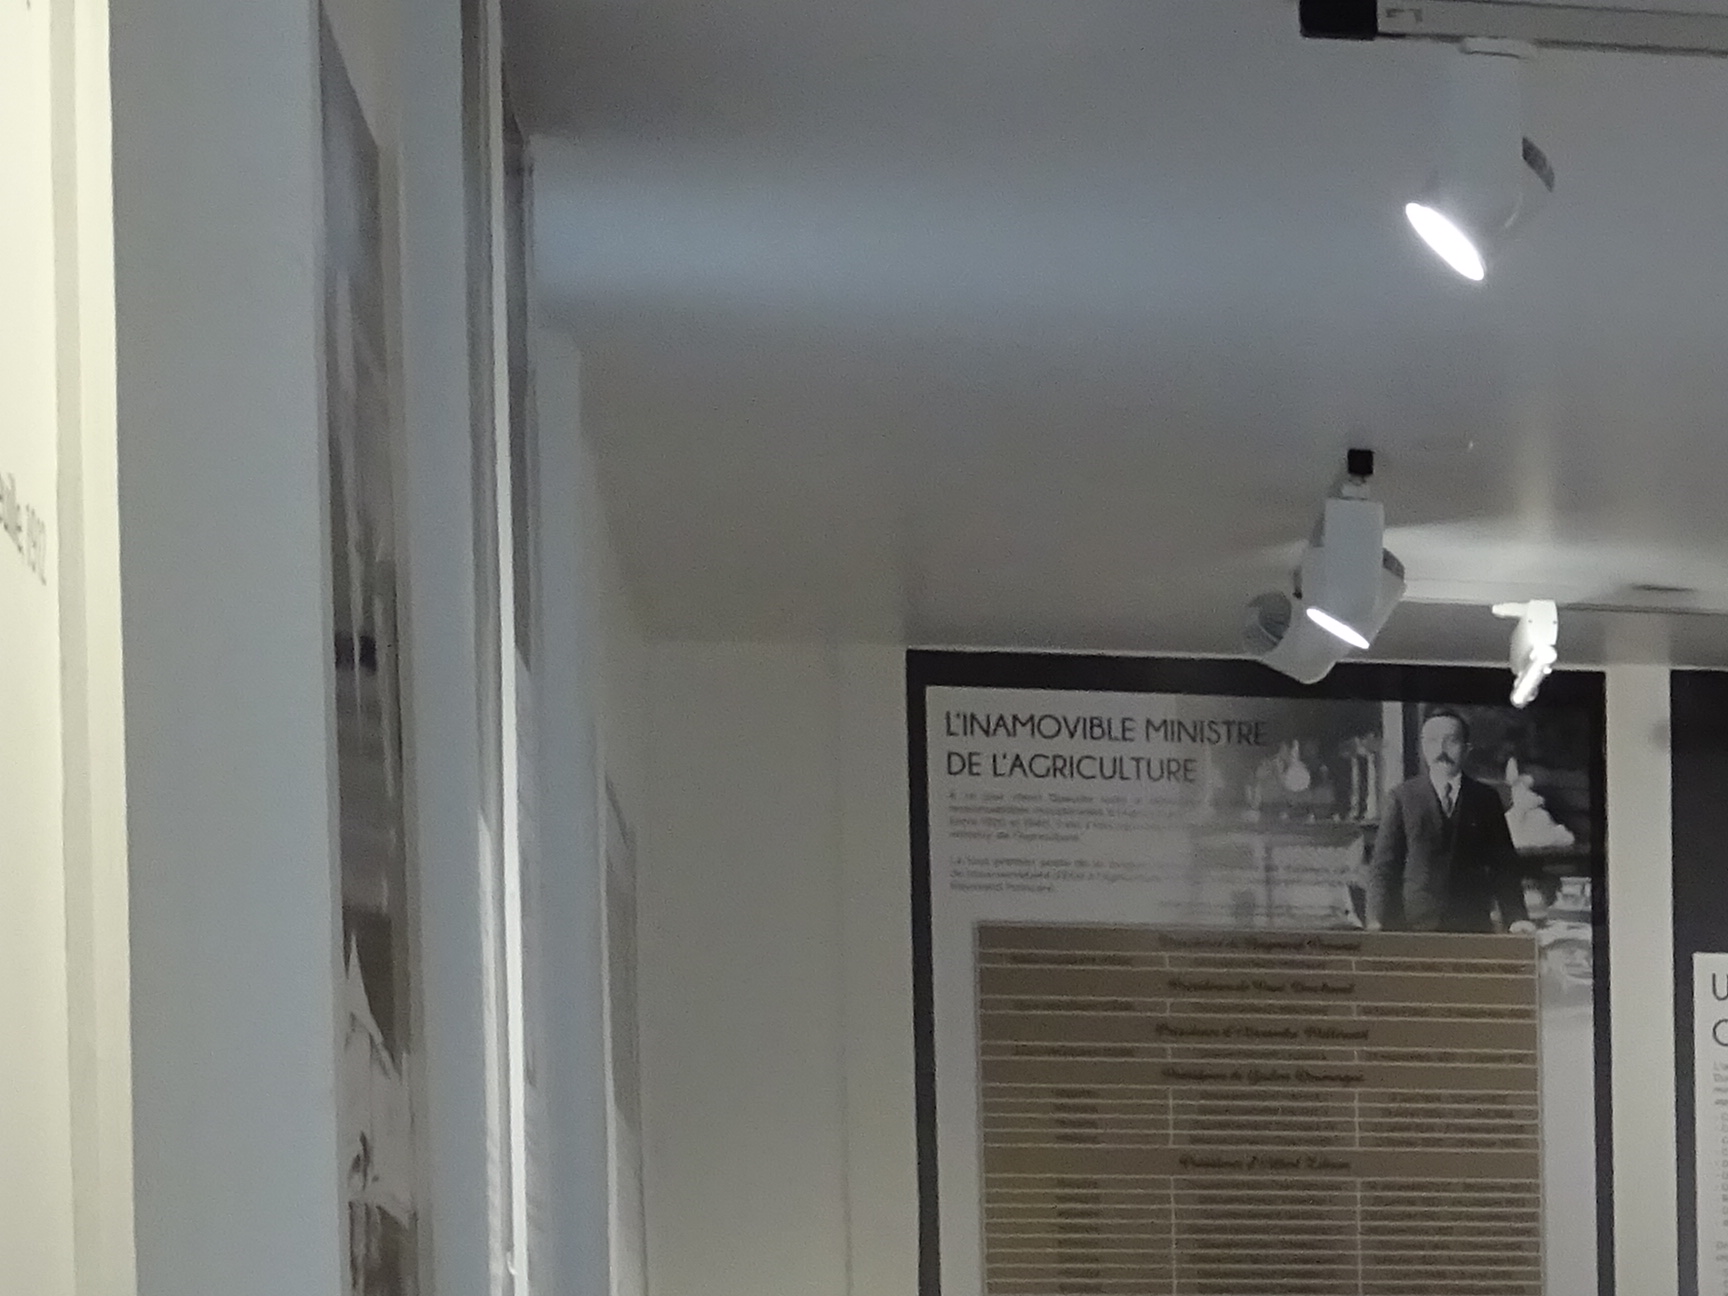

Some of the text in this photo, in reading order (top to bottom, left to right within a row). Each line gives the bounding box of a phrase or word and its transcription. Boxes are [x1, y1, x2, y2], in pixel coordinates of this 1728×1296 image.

[944, 710, 1267, 746] L'INAMOVIBLE MINISTRE
[946, 750, 1197, 784] DE L'AGRICULTURE
